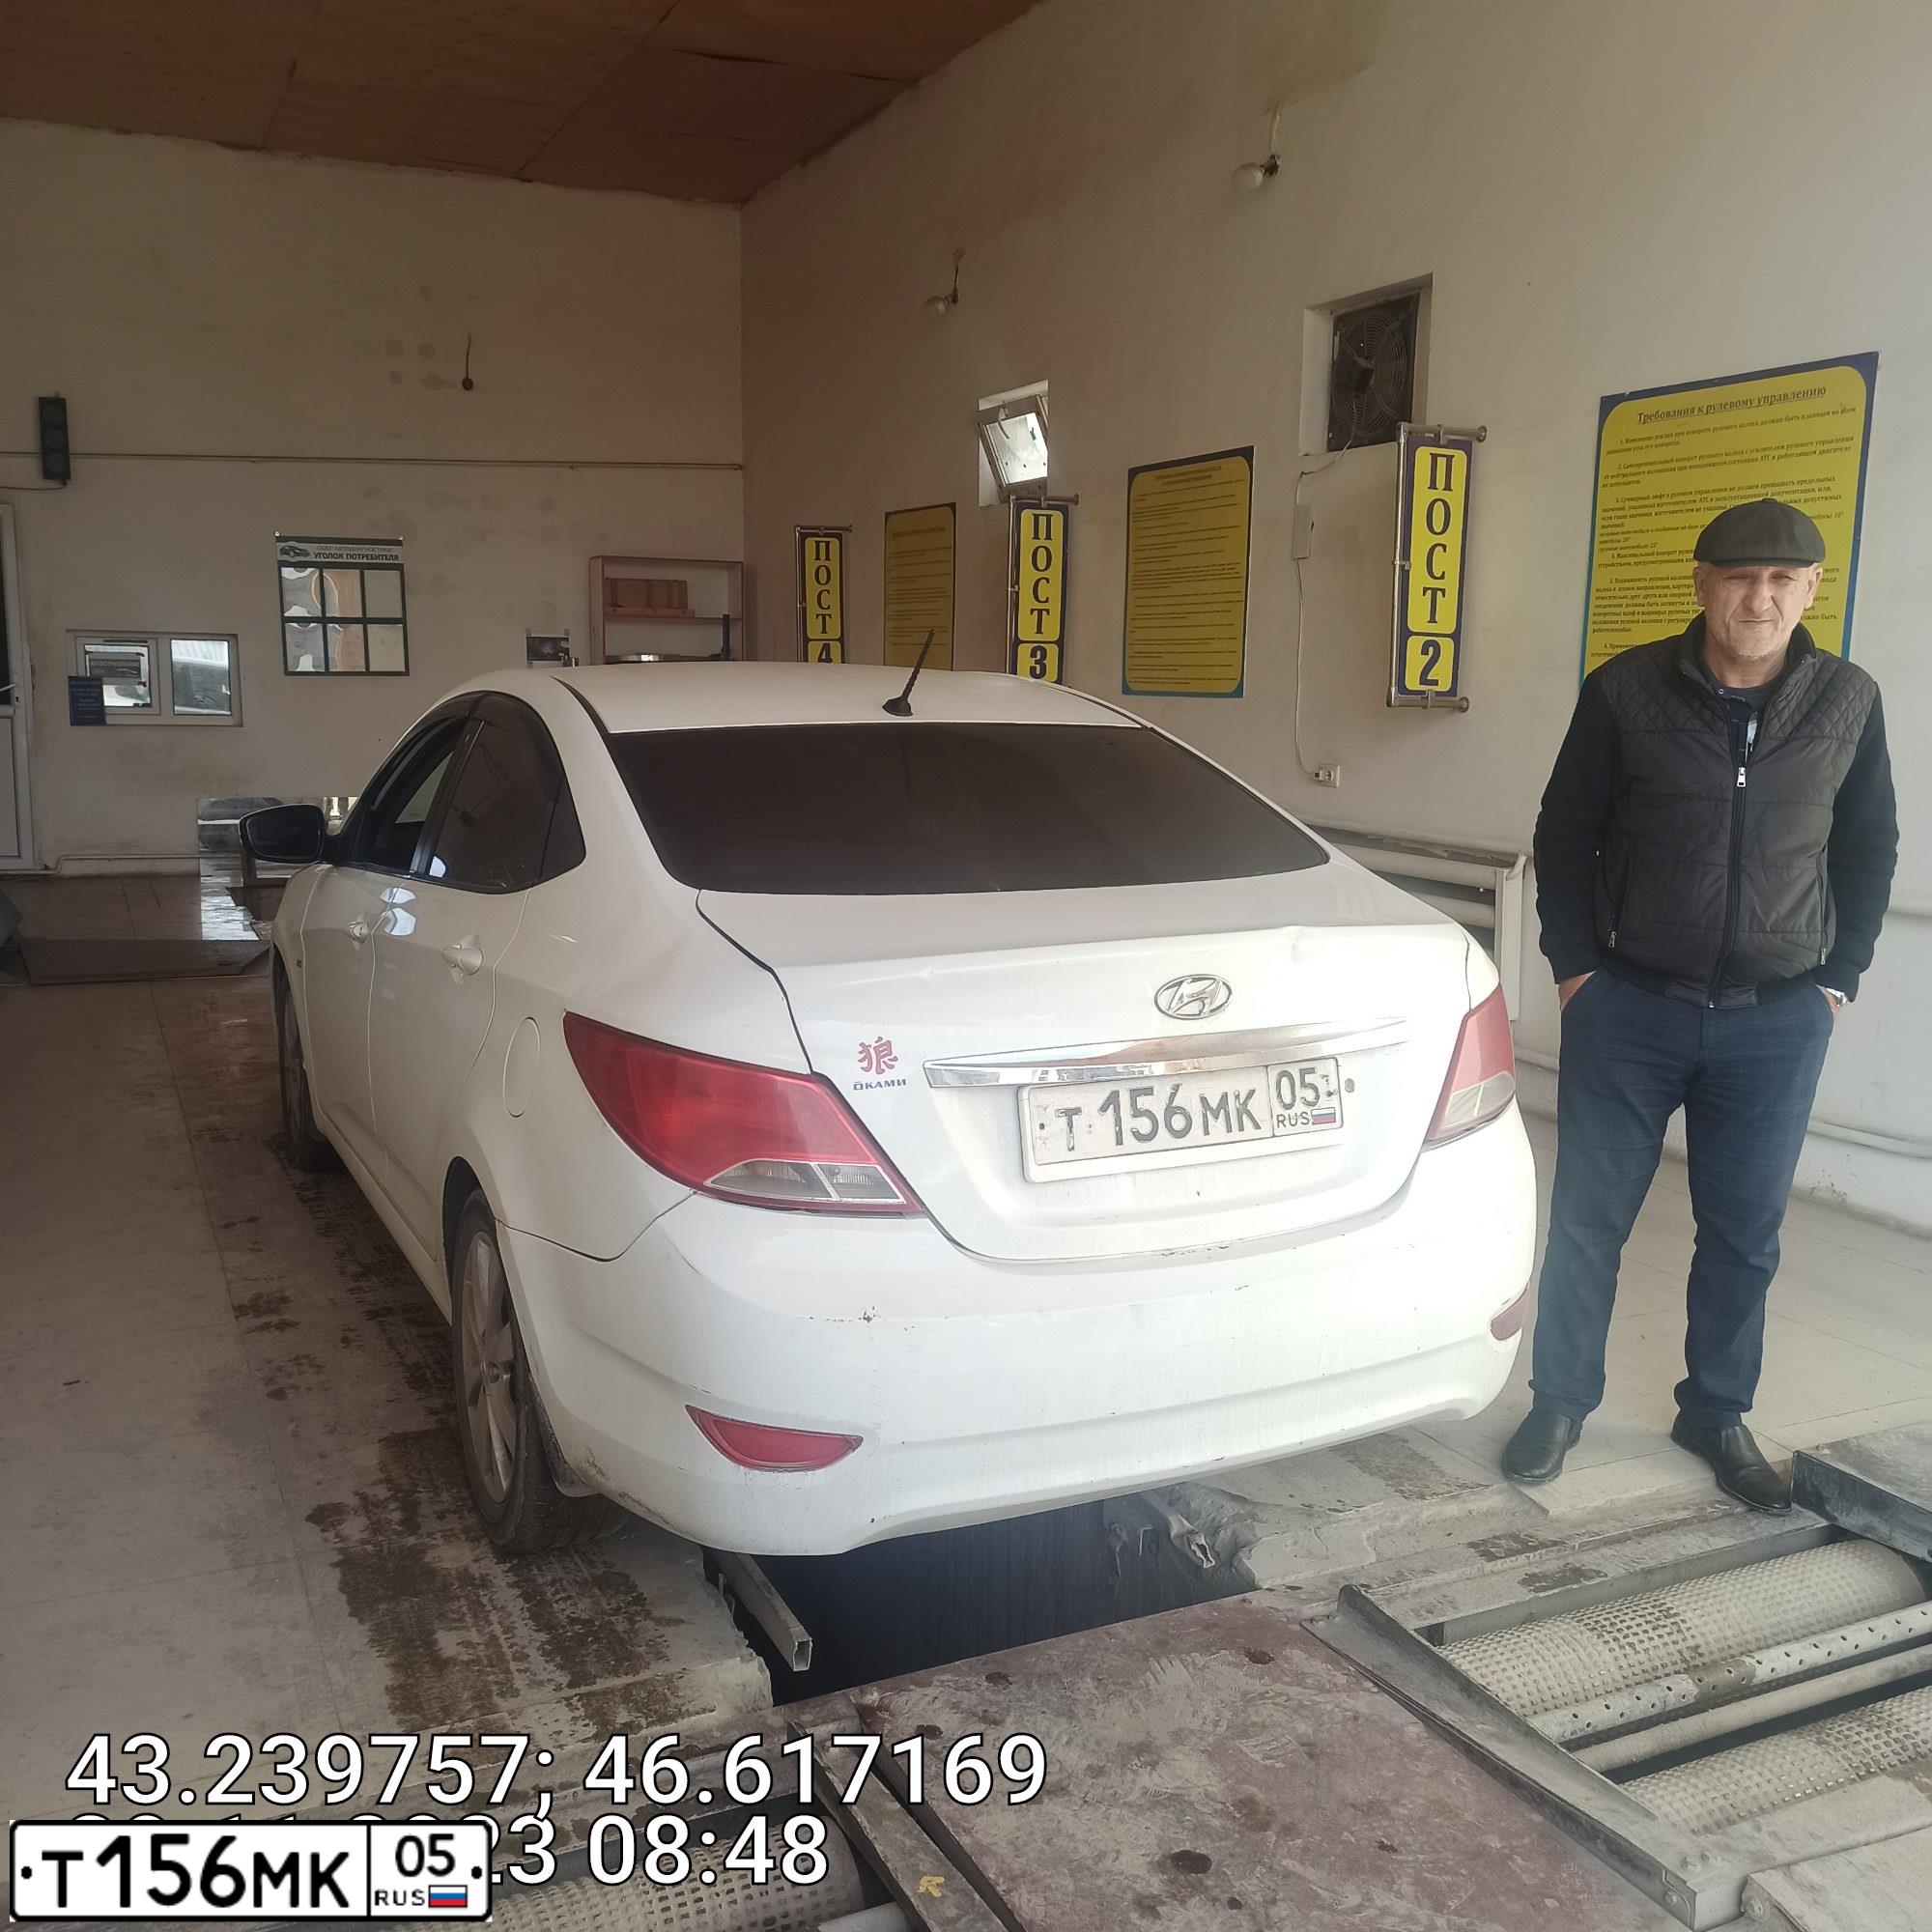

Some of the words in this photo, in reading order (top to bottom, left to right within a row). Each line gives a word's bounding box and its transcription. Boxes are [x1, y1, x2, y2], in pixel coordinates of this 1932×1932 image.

[1637, 406, 1694, 424] Требования
[1705, 398, 1754, 414] рулевому
[1757, 387, 1826, 407] управлению
[314, 552, 344, 560] УГОЛОК
[1422, 452, 1455, 624] ПОСТ
[813, 540, 833, 635] ПОСТ
[1030, 513, 1053, 636] ПОСТ
[817, 642, 833, 664] 4
[1029, 644, 1047, 680] 3
[1418, 639, 1441, 687] 2
[857, 1036, 898, 1075] 狼
[1275, 1067, 1320, 1111] 05
[1276, 1111, 1310, 1128] RUS
